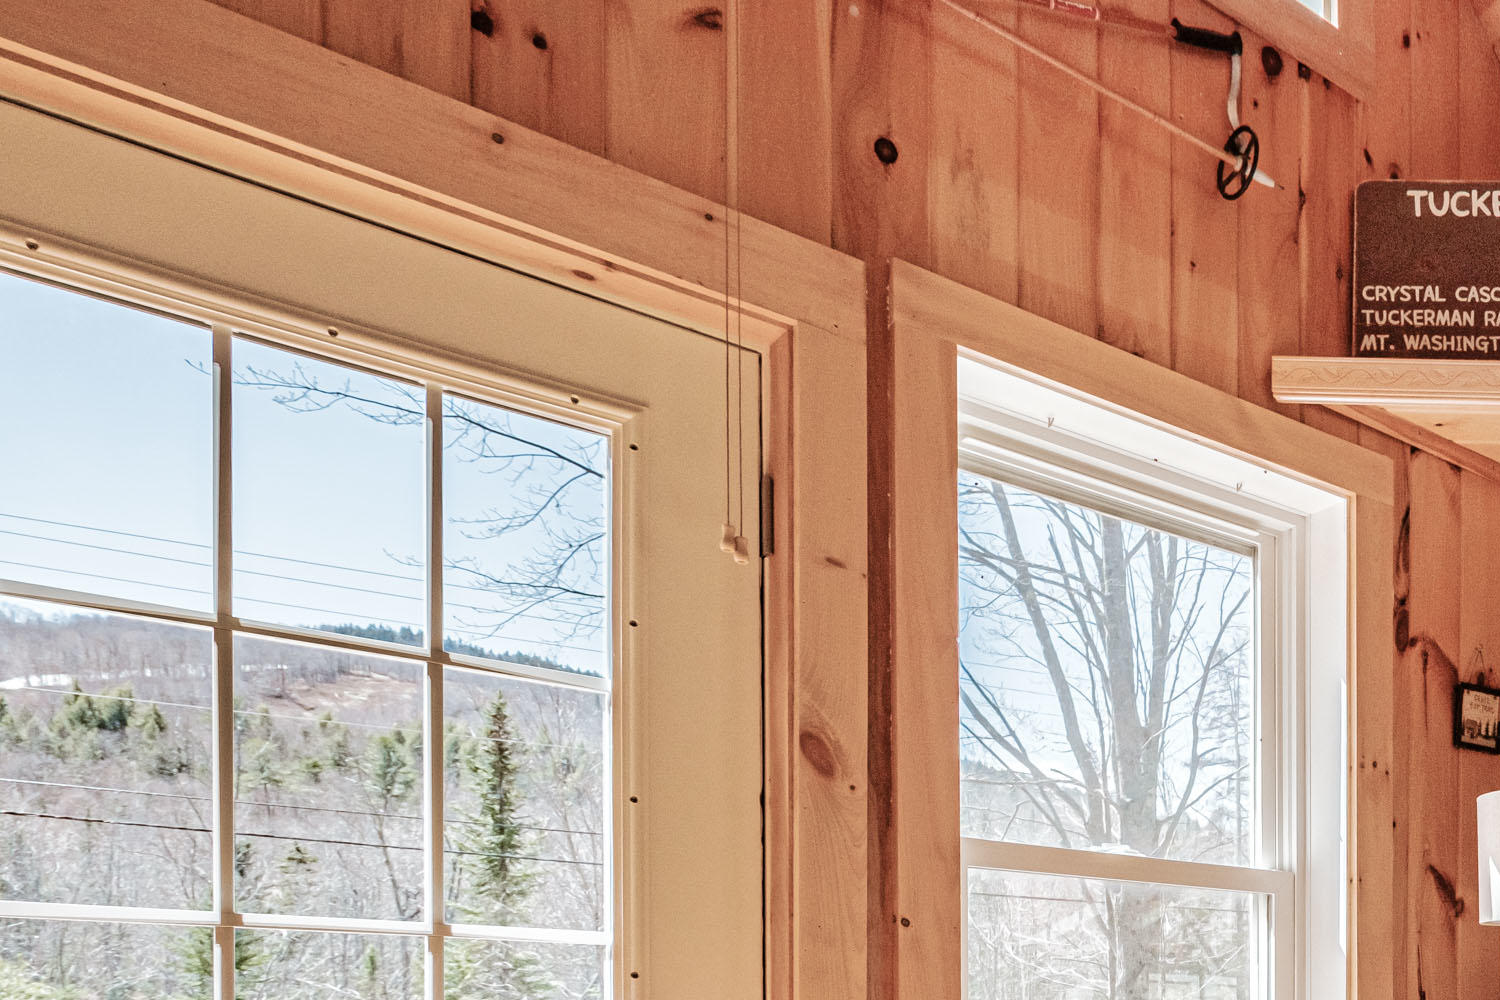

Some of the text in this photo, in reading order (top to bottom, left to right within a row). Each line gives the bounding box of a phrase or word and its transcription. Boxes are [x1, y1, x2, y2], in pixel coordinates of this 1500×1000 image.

[1361, 285, 1446, 302] CRYSTAL
[1361, 309, 1475, 327] TUCKERMAN
[1360, 334, 1396, 352] MT.
